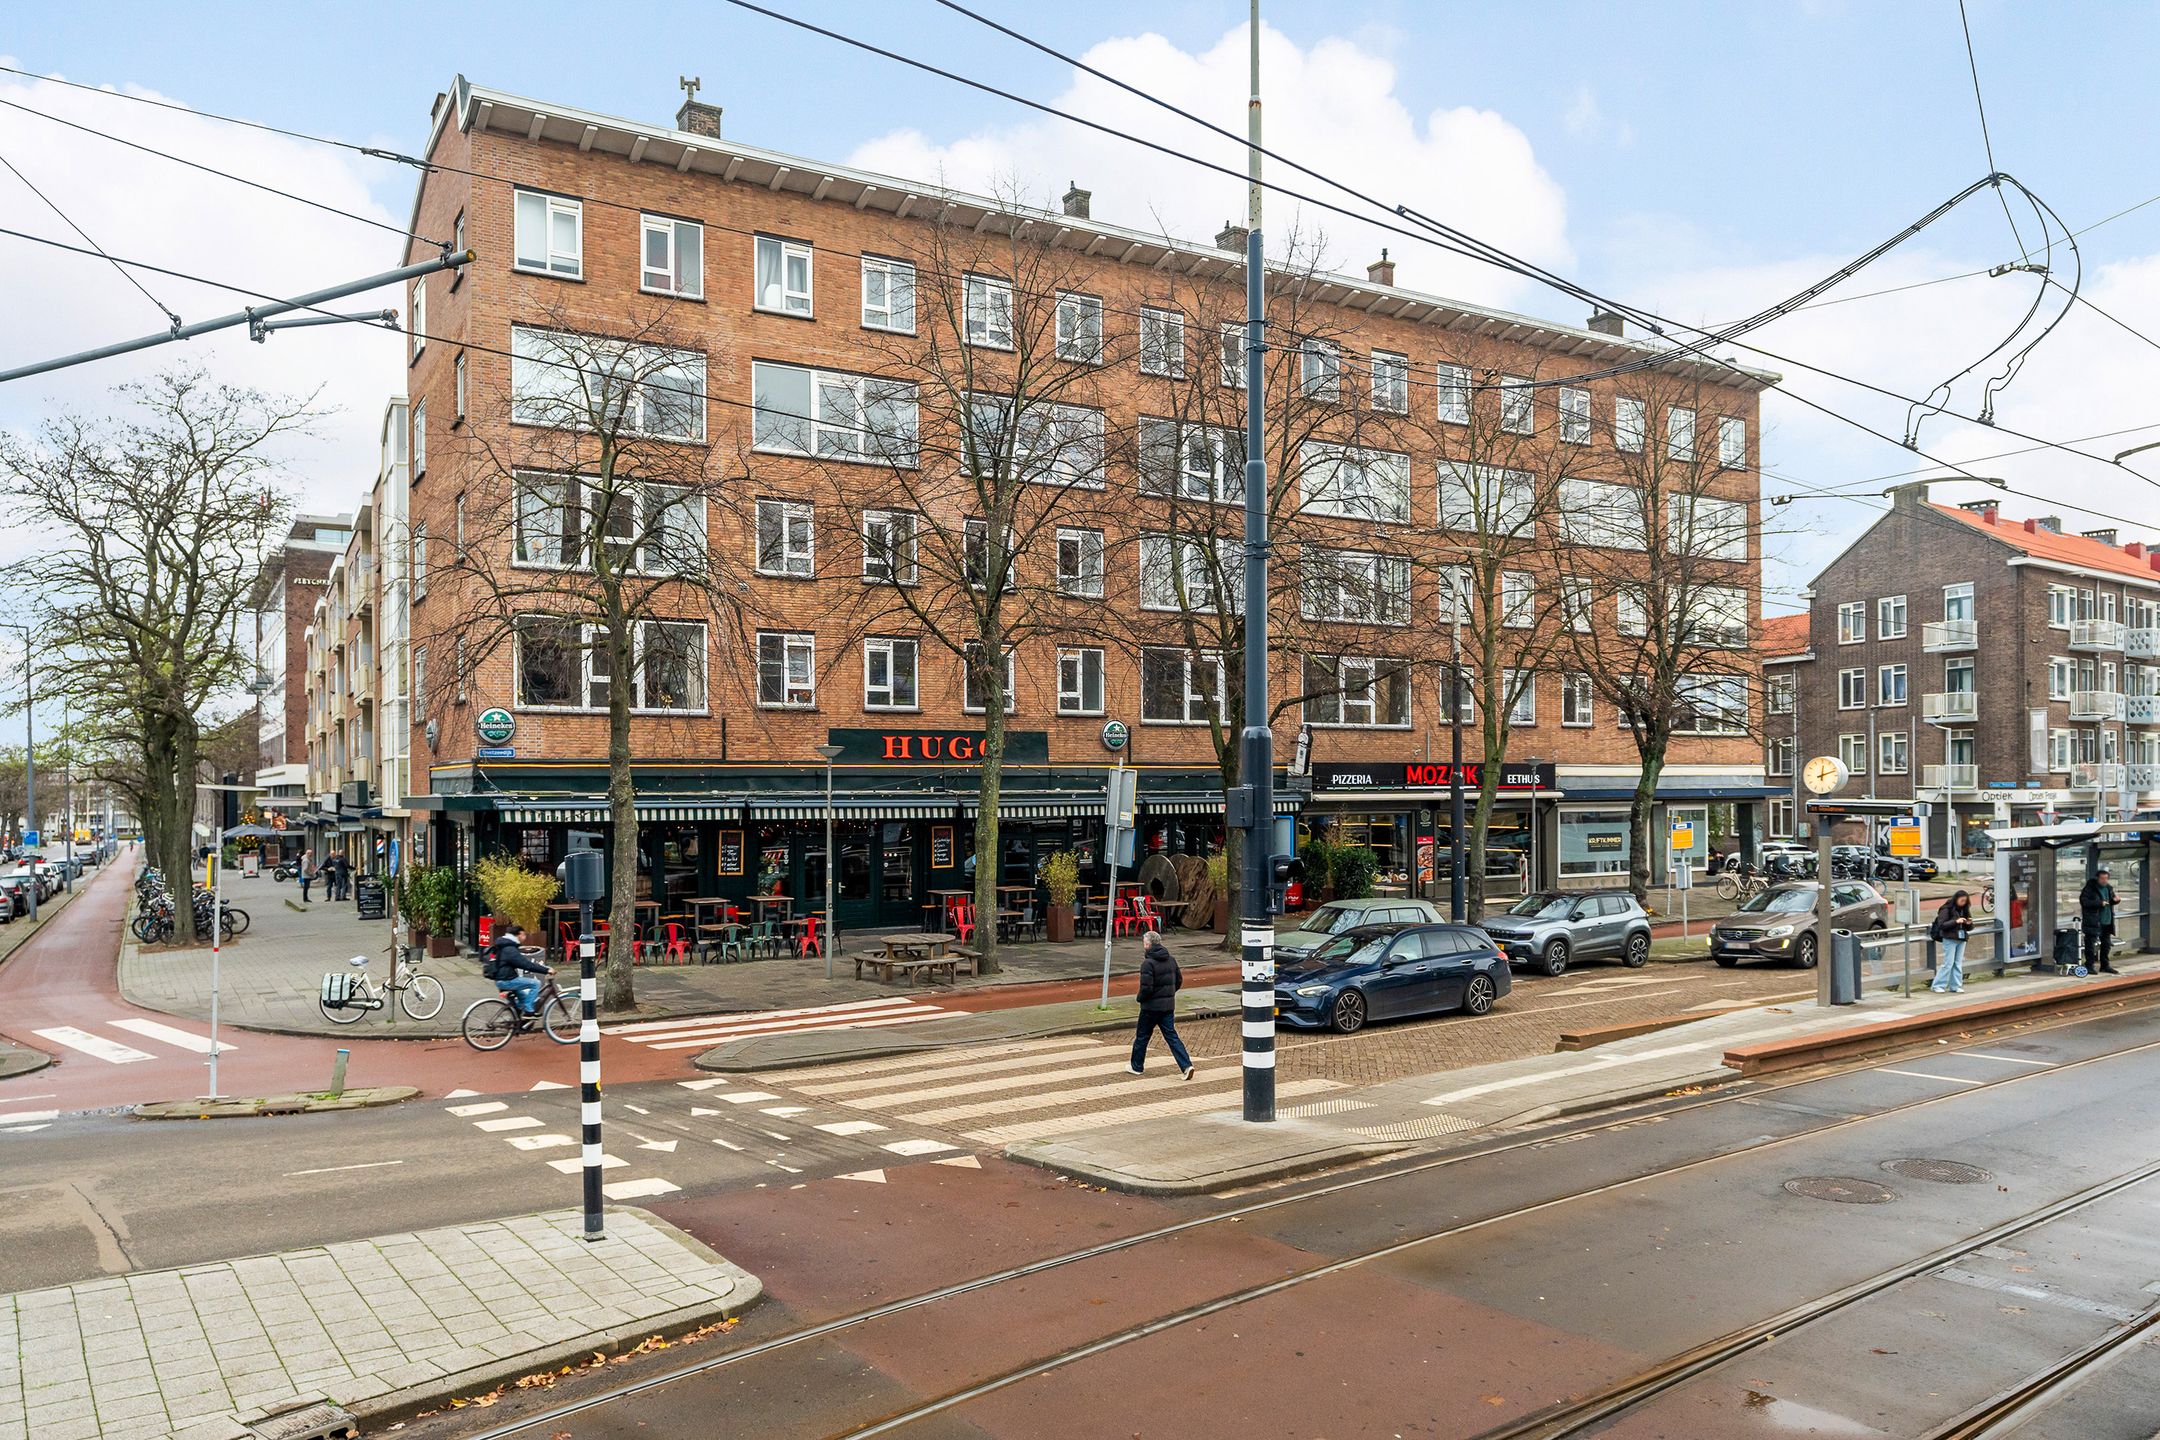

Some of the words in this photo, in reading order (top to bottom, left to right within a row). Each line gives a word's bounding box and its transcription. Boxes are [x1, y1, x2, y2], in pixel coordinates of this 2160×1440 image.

[480, 722, 513, 730] Heineken
[1332, 774, 1373, 785] PIZZERIA
[1507, 774, 1541, 785] EETHUS
[1981, 791, 2014, 801] Optiek
